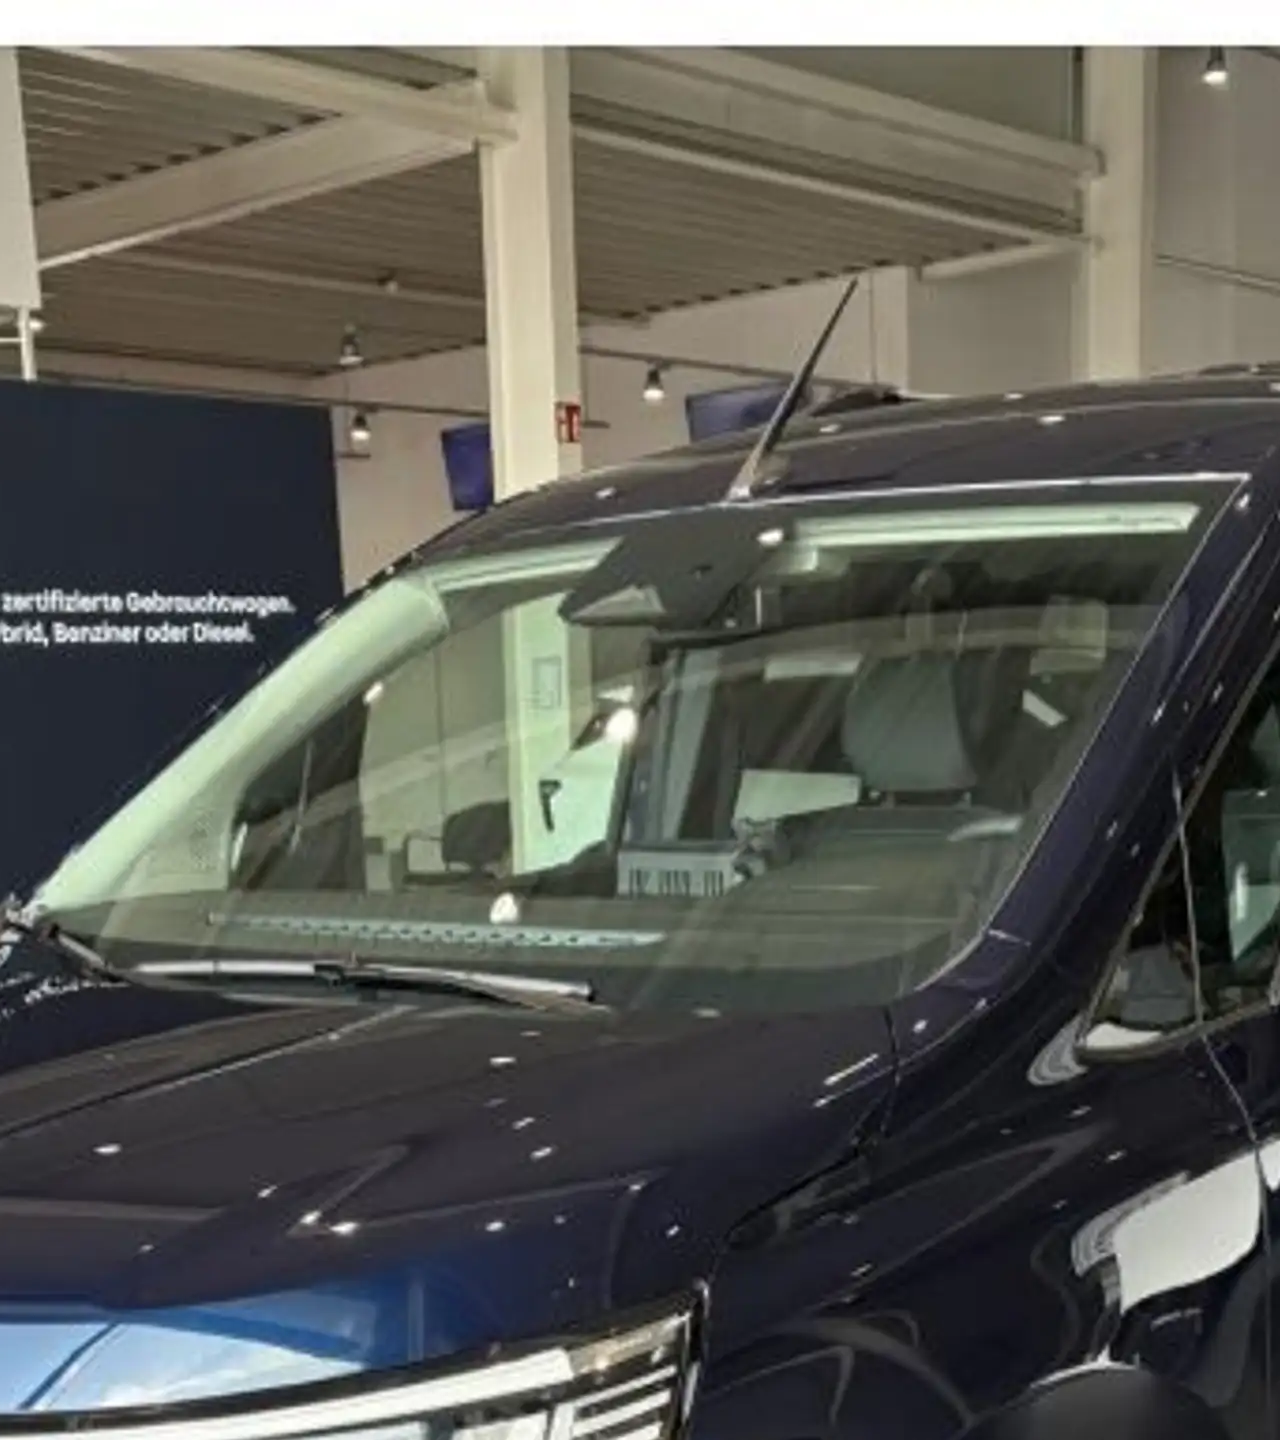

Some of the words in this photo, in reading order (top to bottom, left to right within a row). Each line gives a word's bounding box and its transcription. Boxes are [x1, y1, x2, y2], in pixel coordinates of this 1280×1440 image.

[2, 588, 123, 614] zertifizierte
[51, 620, 142, 644] Benziner
[144, 620, 190, 644] oder
[192, 620, 255, 644] Diesel.
